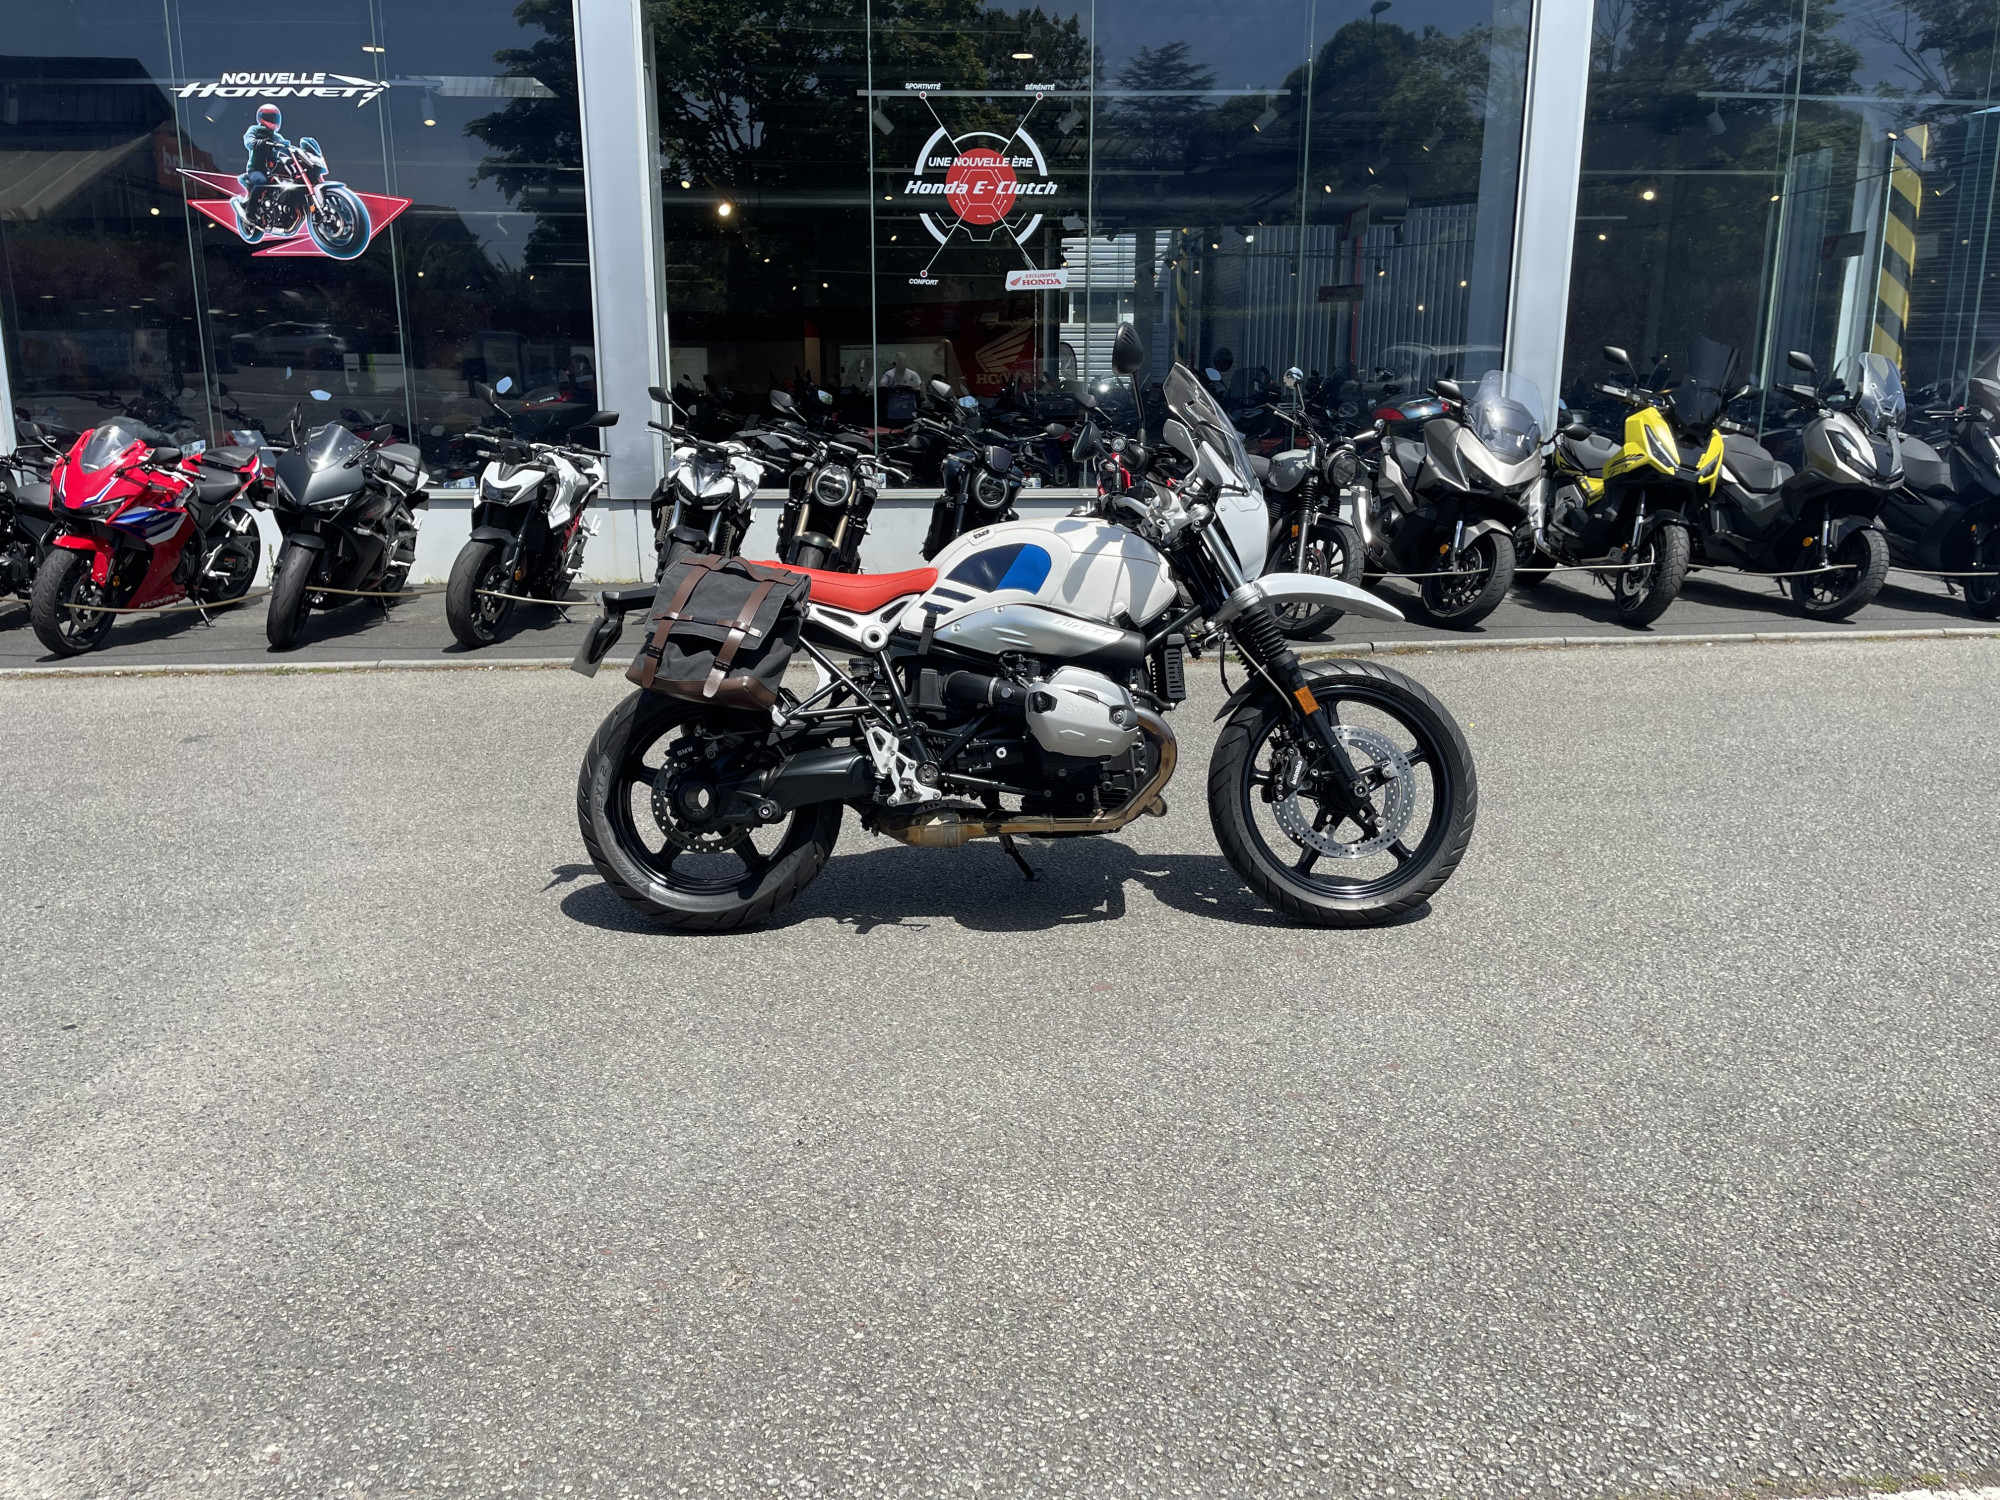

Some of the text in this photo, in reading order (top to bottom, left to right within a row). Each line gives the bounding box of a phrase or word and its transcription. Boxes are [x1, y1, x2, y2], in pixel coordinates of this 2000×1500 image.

[220, 72, 327, 85] NOUVELLE
[169, 80, 381, 99] HORNET
[904, 82, 941, 91] SPORTIVITÉ
[1024, 83, 1056, 91] SÉRÉNITÉ
[928, 156, 1033, 168] UNE NOUVELLE ÈRE
[904, 180, 1058, 195] Honda E-Clutch
[908, 278, 939, 286] CONFORT
[1022, 278, 1062, 286] HONDA
[139, 593, 180, 609] HONDA
[676, 745, 694, 757] BMW
